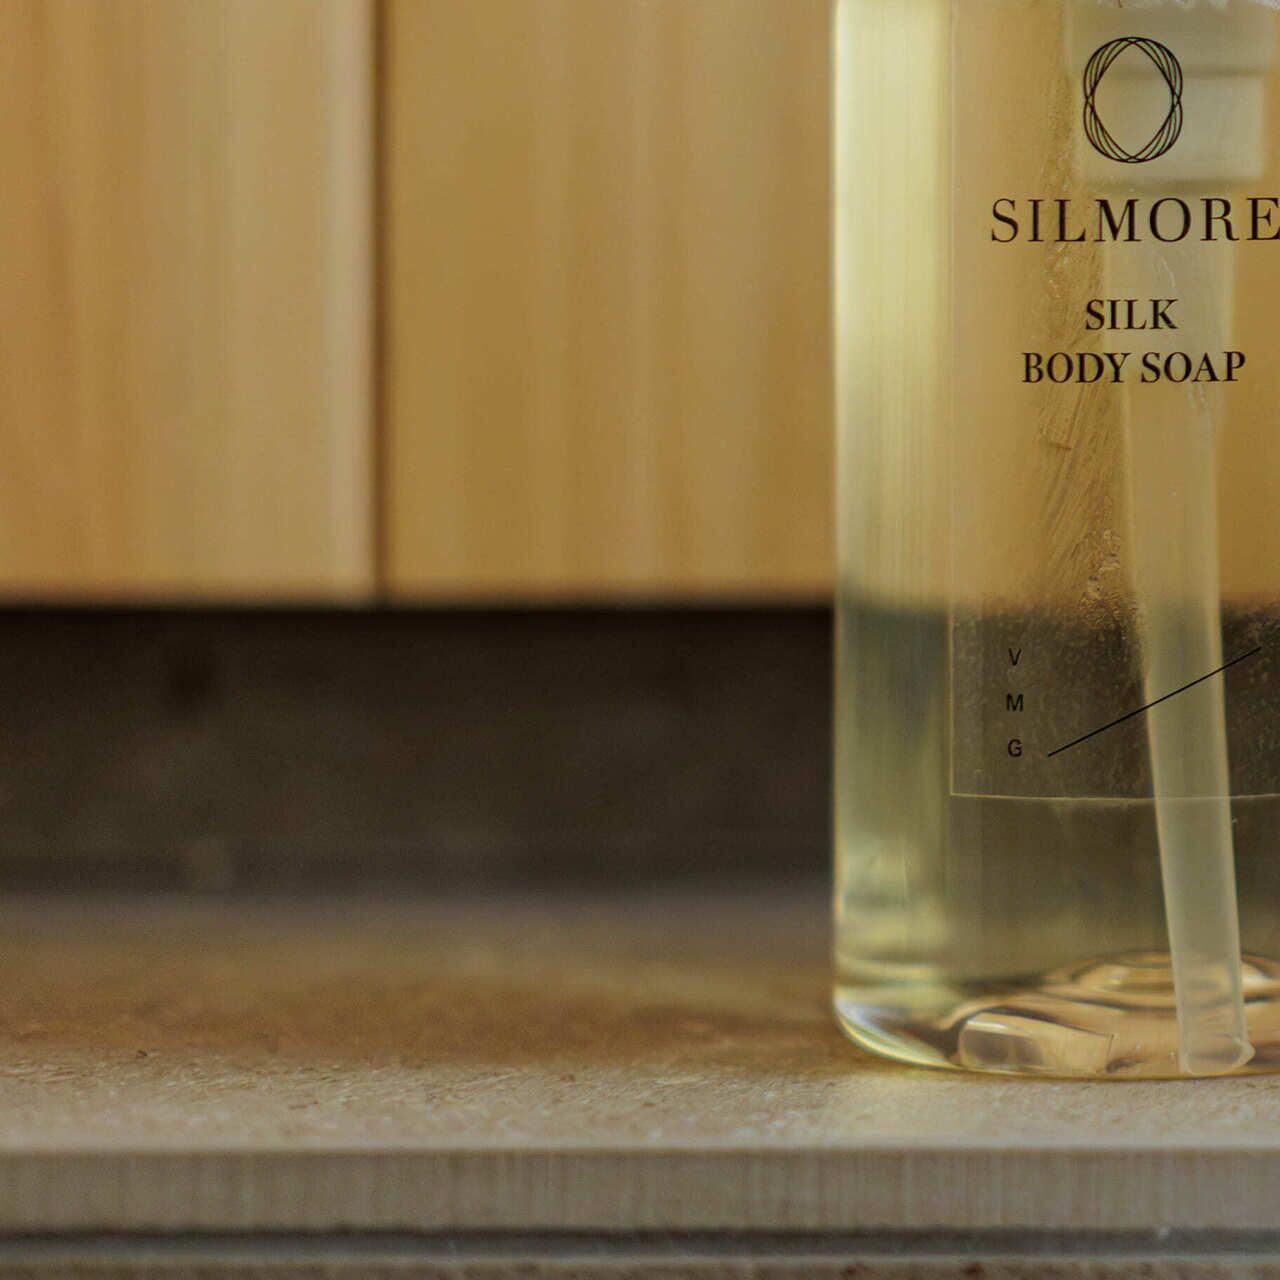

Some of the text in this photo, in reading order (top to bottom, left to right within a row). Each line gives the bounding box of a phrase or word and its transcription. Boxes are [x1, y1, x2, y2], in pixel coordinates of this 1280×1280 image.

[1085, 298, 1179, 331] SILK
[1022, 351, 1246, 384] BODY SOAP
[1008, 648, 1022, 667] V
[1006, 693, 1024, 712] M
[1007, 739, 1022, 758] G
